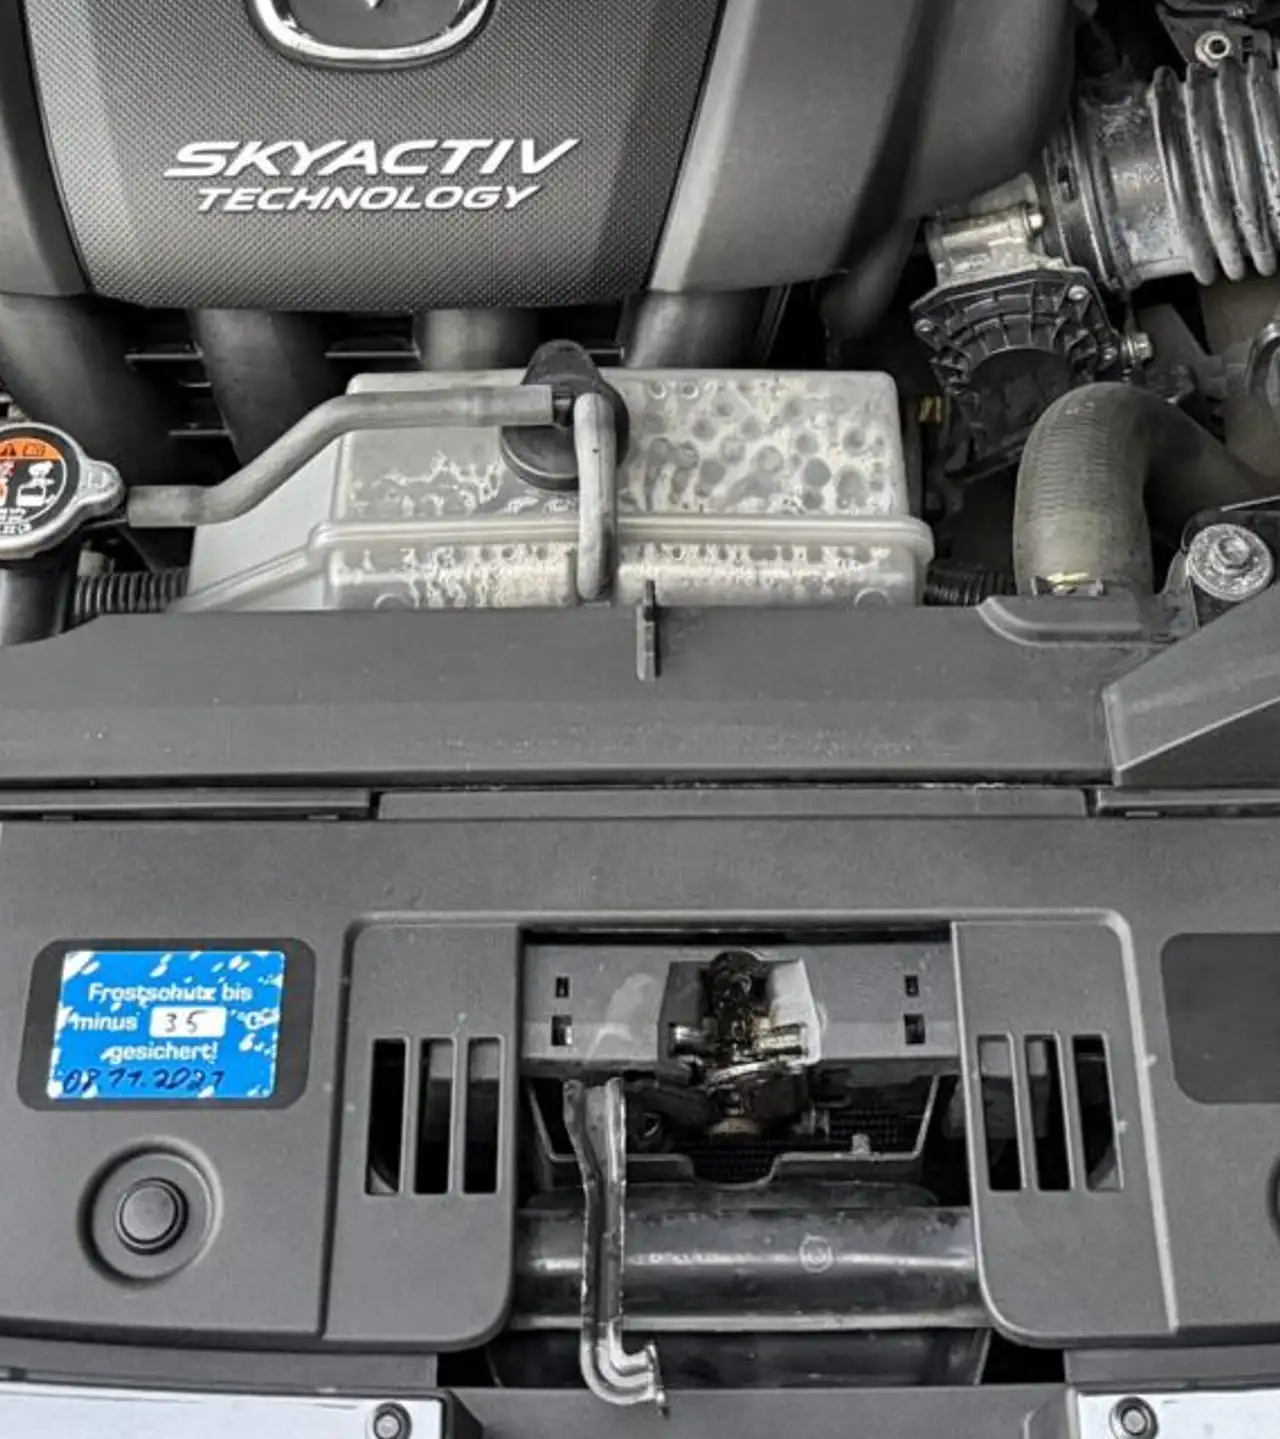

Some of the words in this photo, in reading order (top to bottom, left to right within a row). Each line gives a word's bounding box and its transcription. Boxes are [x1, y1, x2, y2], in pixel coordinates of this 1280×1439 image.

[163, 139, 580, 177] SKYACTIV
[197, 186, 541, 212] TECHNOLOGY
[88, 982, 217, 1007] Frostschutz
[222, 982, 254, 1002] bis
[75, 1013, 138, 1031] minus
[164, 1010, 208, 1034] 35
[109, 1041, 218, 1065] gesichert!
